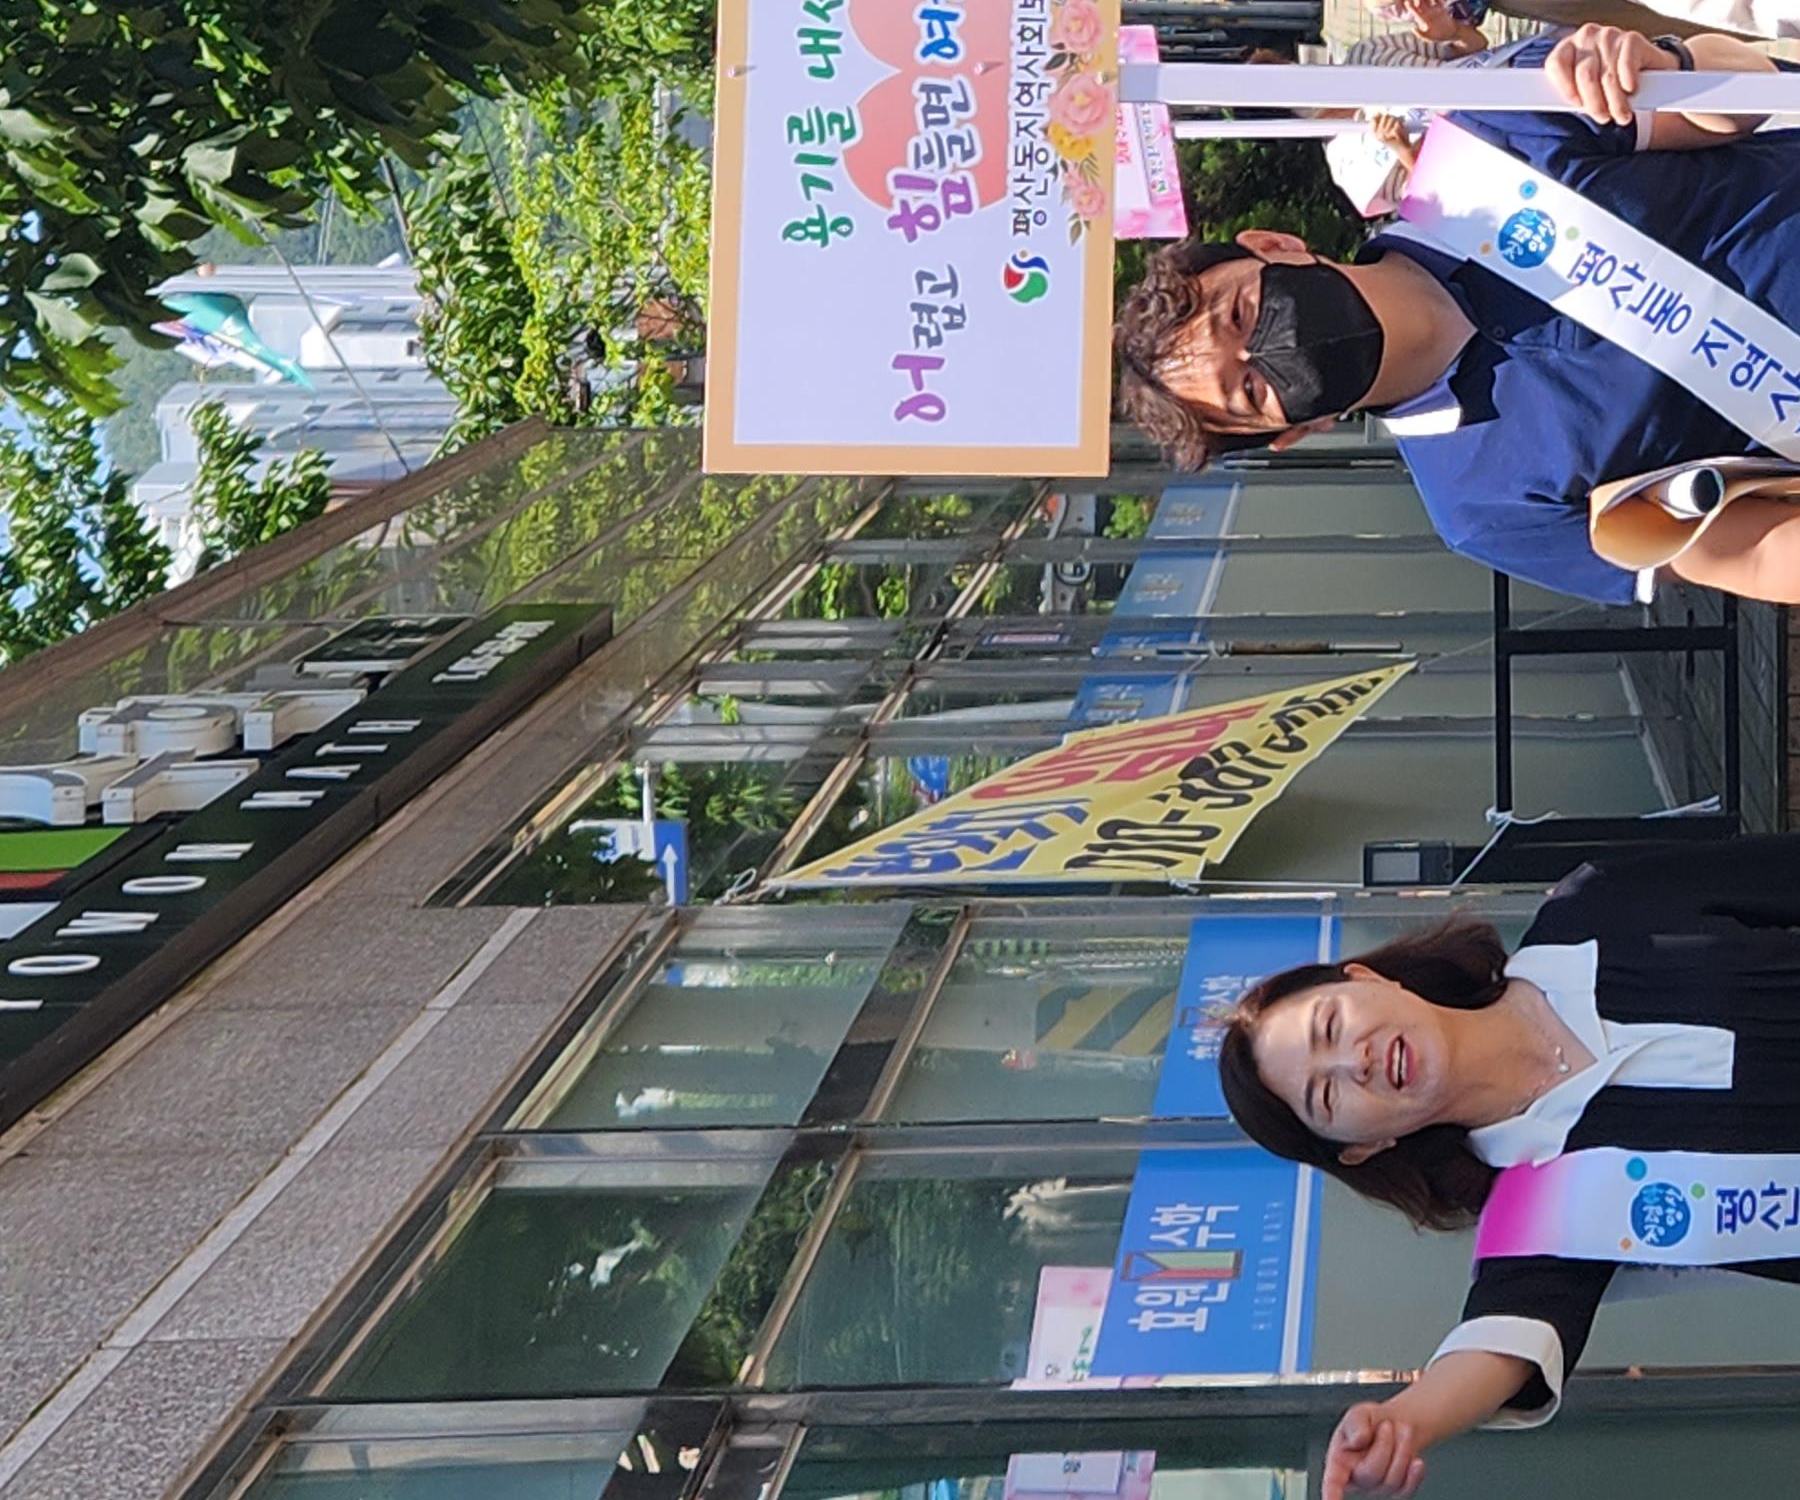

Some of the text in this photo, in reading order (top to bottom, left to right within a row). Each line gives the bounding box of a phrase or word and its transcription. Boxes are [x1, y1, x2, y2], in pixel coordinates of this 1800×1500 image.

[781, 104, 856, 248] 용기를
[886, 78, 977, 241] 힘들면
[891, 263, 967, 422] 어렵고
[1566, 241, 1693, 336] 평산동
[238, 719, 422, 809] MATH
[1127, 1203, 1240, 1332] 효원 수학
